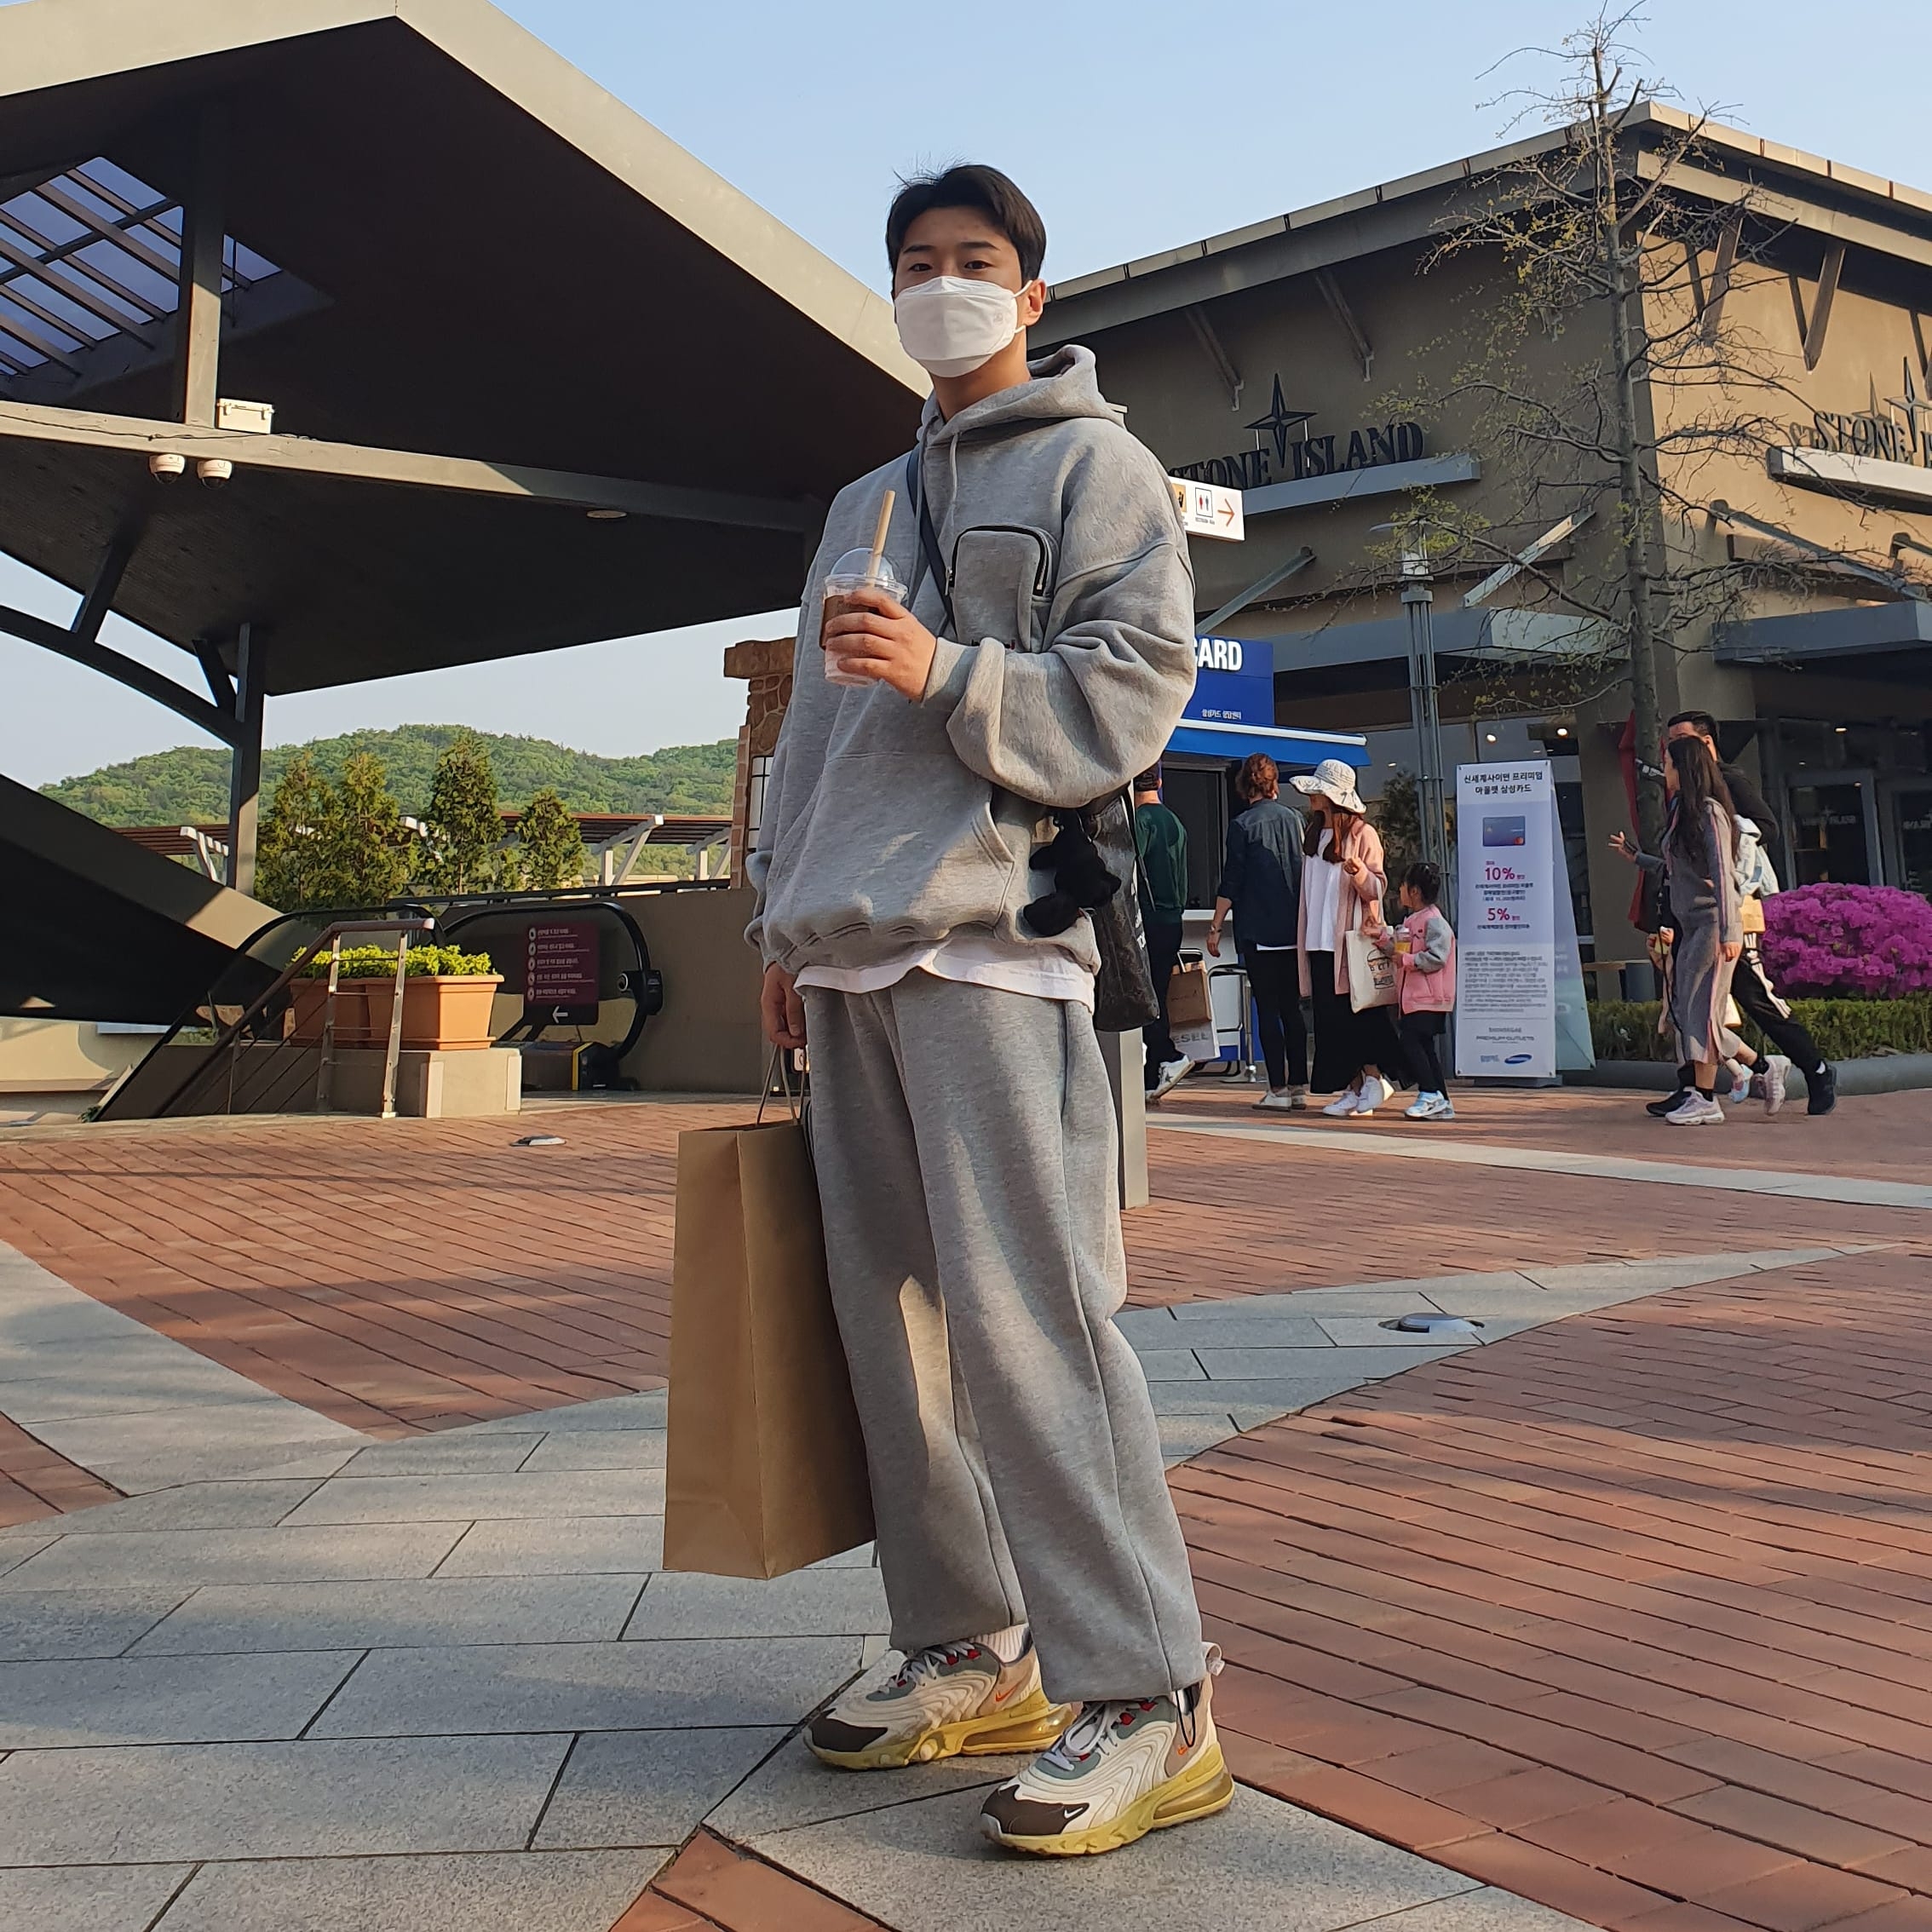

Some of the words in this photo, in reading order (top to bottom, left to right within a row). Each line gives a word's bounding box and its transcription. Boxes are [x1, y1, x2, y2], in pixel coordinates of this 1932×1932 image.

[1814, 411, 1913, 464] STONE
[1291, 422, 1423, 480] ISLAND
[1193, 638, 1242, 671] ARD
[1485, 867, 1515, 881] 10%
[1487, 907, 1510, 921] 5%
[1173, 1031, 1209, 1044] ESEL
